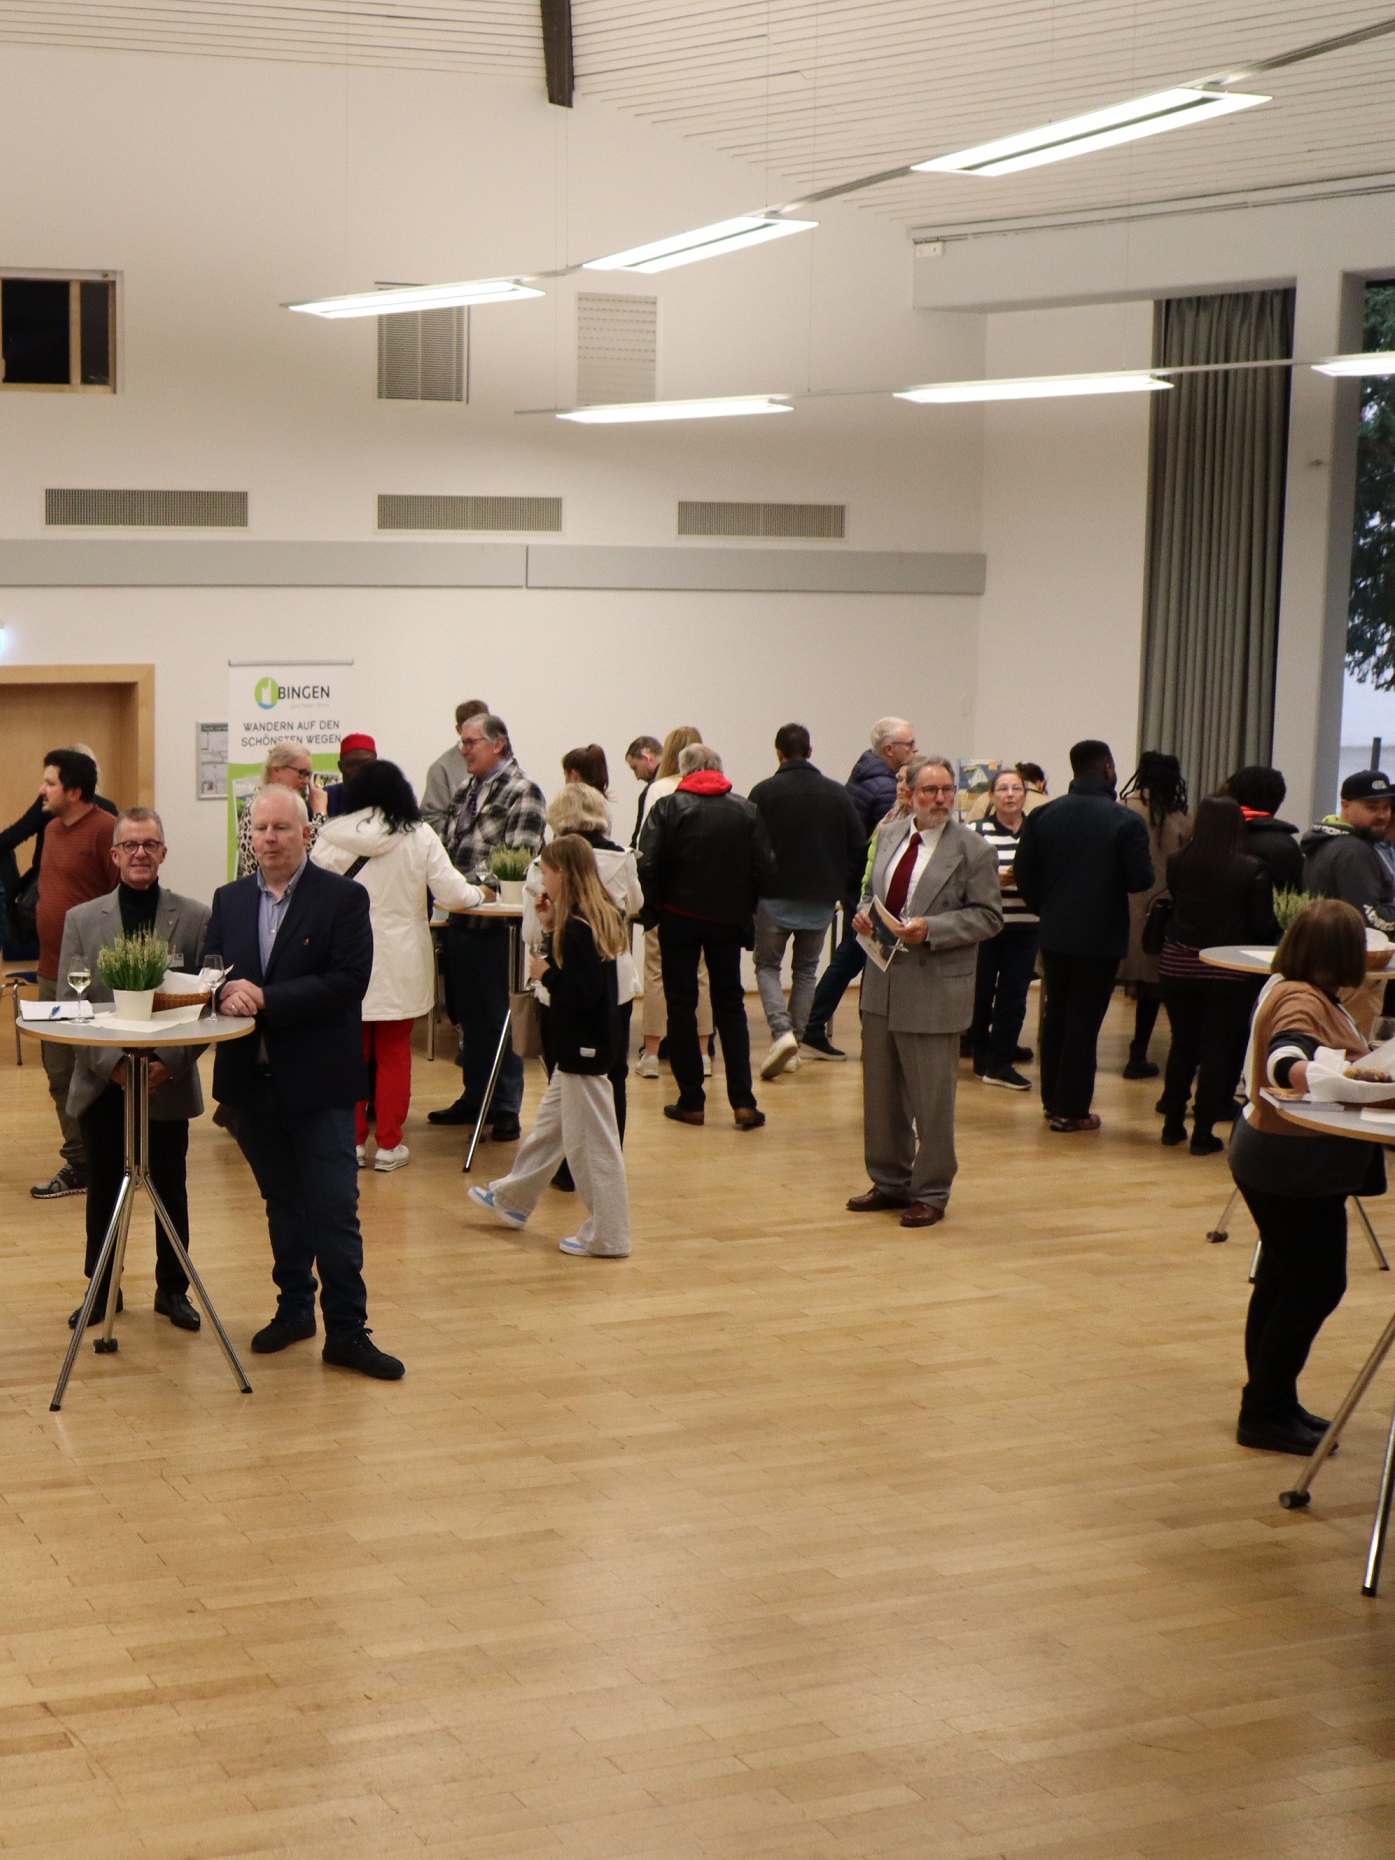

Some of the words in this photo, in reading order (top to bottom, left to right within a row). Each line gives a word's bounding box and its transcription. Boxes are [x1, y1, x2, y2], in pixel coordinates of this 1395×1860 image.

[278, 685, 330, 700] BINGEN
[243, 721, 294, 732] WANDERN
[297, 720, 316, 731] AUF
[319, 719, 340, 730] DEN
[306, 733, 342, 745] WEGEN
